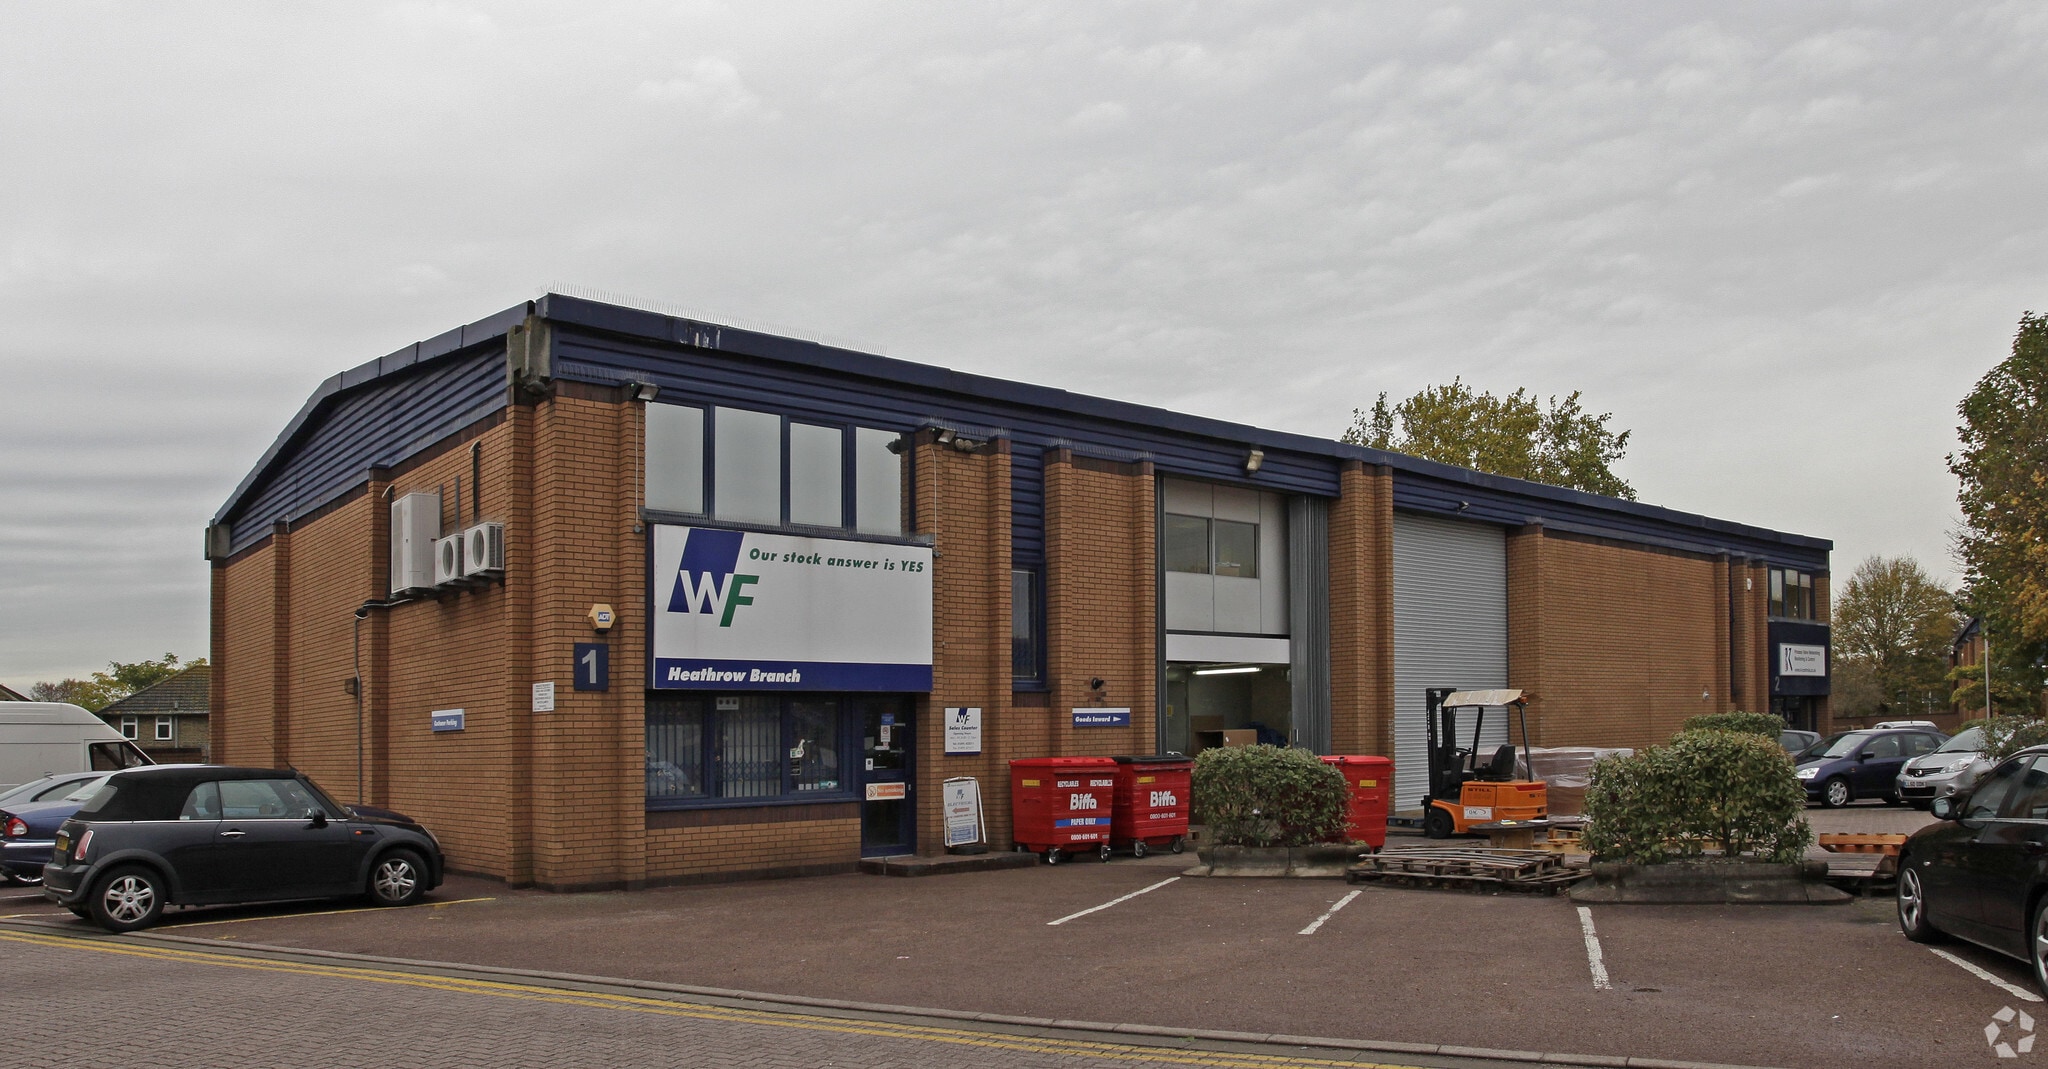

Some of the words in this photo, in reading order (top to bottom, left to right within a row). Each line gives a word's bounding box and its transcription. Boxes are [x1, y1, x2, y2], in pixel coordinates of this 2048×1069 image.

[749, 548, 777, 562] Our
[783, 551, 822, 565] stock
[827, 556, 878, 570] answer
[884, 558, 895, 571] is
[901, 560, 924, 573] YES
[667, 569, 760, 628] WF
[598, 613, 610, 621] ADT
[581, 649, 597, 684] 1
[668, 667, 747, 683] Heathrow
[749, 667, 801, 683] Branch
[1774, 676, 1780, 691] 2
[1070, 793, 1097, 810] Biffa
[1150, 790, 1177, 807] Biffa
[1071, 818, 1084, 826] PAPER
[1085, 817, 1096, 825] ONLY
